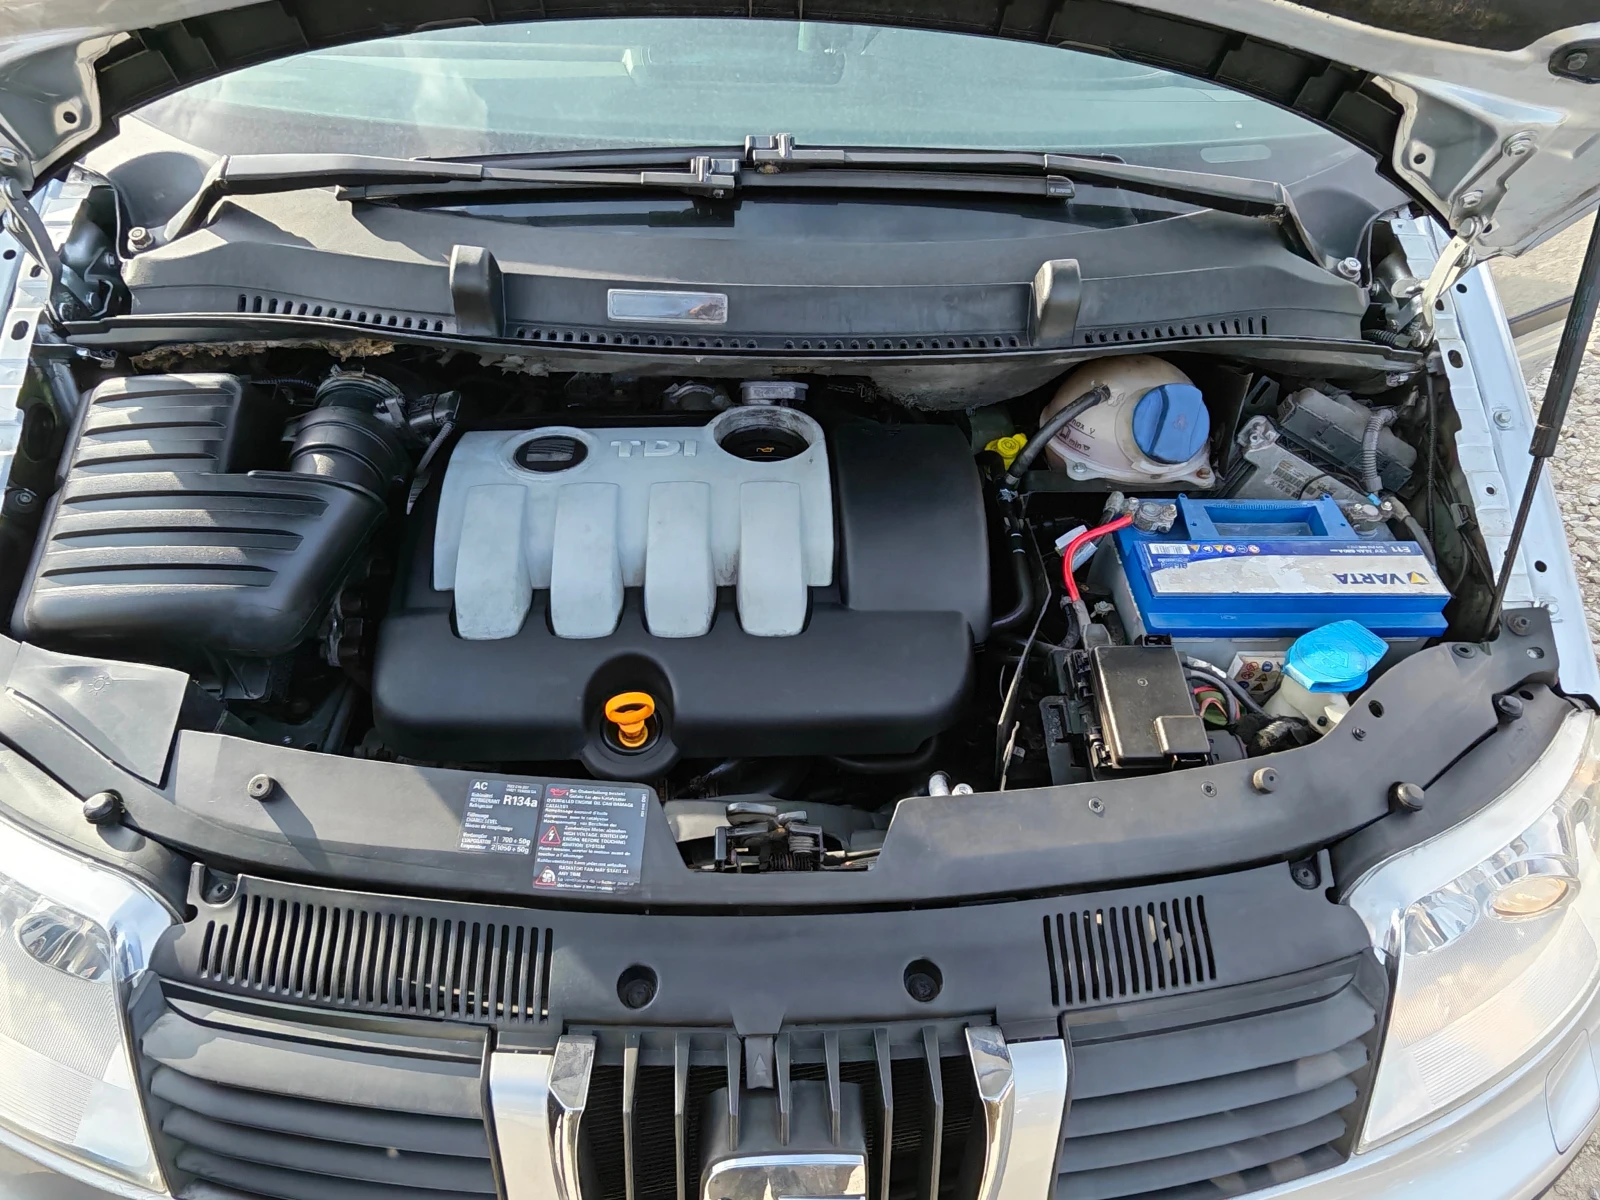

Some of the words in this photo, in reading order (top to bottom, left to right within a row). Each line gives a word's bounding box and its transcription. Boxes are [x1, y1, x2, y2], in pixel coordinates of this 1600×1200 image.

[610, 440, 697, 457] TDI
[1069, 439, 1082, 449] min
[1390, 545, 1411, 553] E11
[1332, 573, 1406, 585] VARTA
[473, 781, 488, 790] AC
[503, 794, 538, 808] R134a
[519, 838, 531, 846] 50g
[516, 846, 529, 855] 50g
